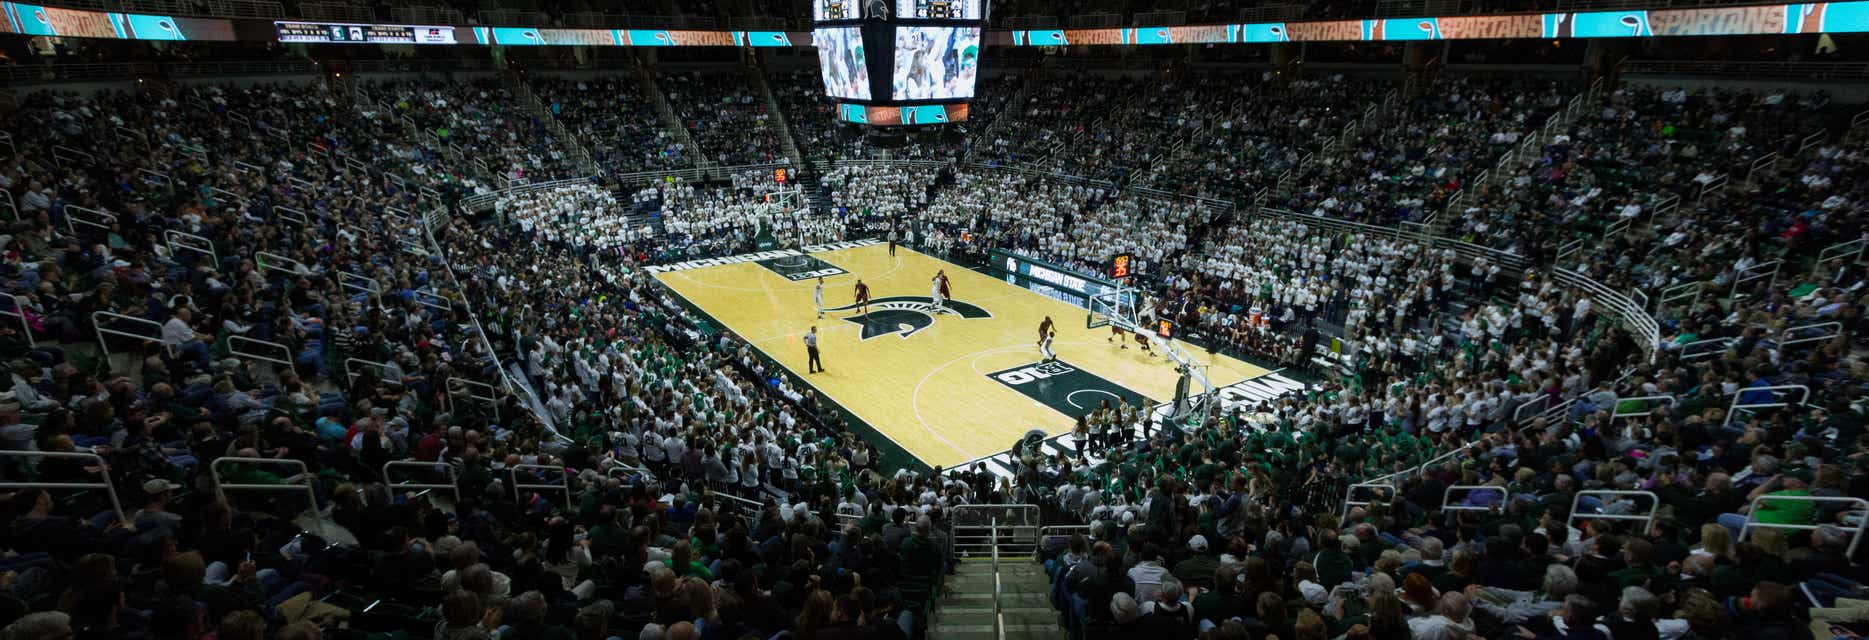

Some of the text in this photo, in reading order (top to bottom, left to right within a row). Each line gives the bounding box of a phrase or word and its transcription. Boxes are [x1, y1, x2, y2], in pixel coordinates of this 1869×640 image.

[1066, 29, 1123, 45] SPARTANS
[1287, 21, 1362, 42] SPARTANS
[1439, 15, 1543, 39] SPARTANS
[672, 32, 735, 46] SPARTANS
[640, 249, 803, 274] MICHIGAN
